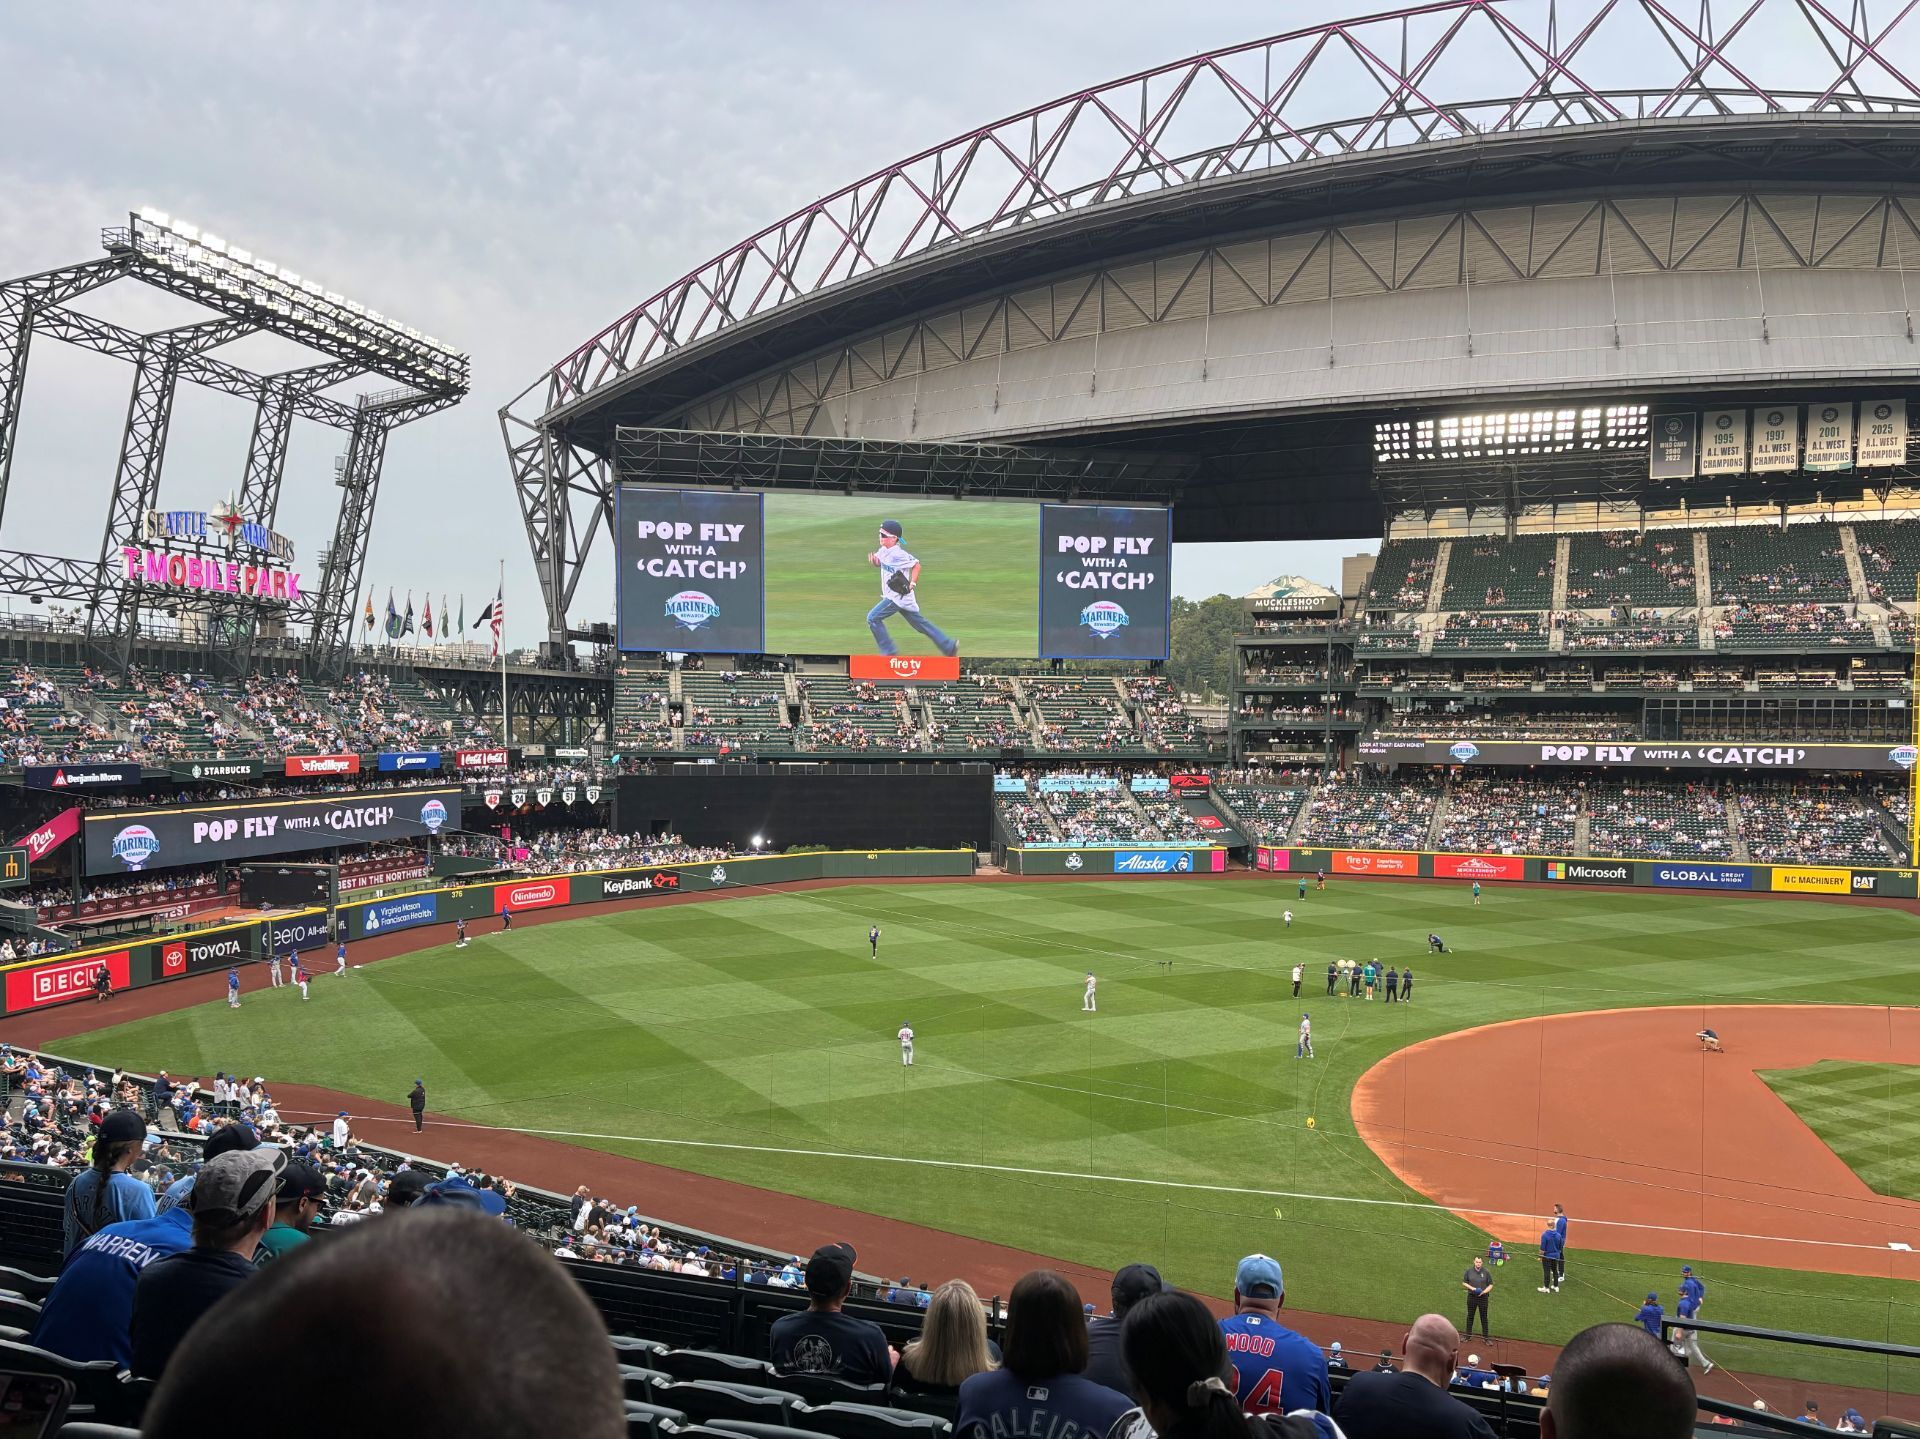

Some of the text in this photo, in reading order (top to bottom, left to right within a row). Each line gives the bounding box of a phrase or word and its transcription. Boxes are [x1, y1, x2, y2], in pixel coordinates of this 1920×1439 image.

[1819, 427, 1840, 438] 2001
[1872, 424, 1893, 434] 2025
[1714, 434, 1734, 444] 1995
[1765, 430, 1785, 441] 1997
[1758, 442, 1791, 453] A.L. WEST
[1812, 440, 1846, 450] A.L. WEST
[1866, 437, 1898, 447] A.L. WEST
[1707, 447, 1739, 457] A.L. WEST
[1808, 452, 1849, 463] CHAMPIONS
[1861, 449, 1902, 460] CHAMPIONS
[1703, 458, 1743, 469] CHAMPIONS
[1754, 455, 1795, 466] CHAMPIONS
[146, 510, 207, 538] SEATTLE
[638, 521, 745, 542] POP FLY
[241, 521, 294, 562] MARINERS
[1058, 535, 1154, 555] POP FLY
[665, 544, 716, 556] WITH A
[1081, 557, 1128, 568] WITH A
[122, 547, 300, 600] T-MOBILE PARK
[664, 600, 720, 617] MARINERS
[1255, 598, 1326, 607] MUCKLESHOOT
[1080, 611, 1129, 626] MARINERS
[890, 657, 921, 669] fire tv
[1541, 745, 1589, 761] POP
[1595, 746, 1636, 761] FLY
[1644, 750, 1678, 759] WITH
[1681, 750, 1692, 759] A
[204, 765, 251, 776] STARBUCKS
[67, 772, 123, 784] Benjamin Moore
[488, 796, 498, 805] 42
[515, 795, 524, 803] 24
[542, 794, 548, 803] 11
[566, 793, 574, 801] 51
[590, 792, 597, 800] 51
[193, 819, 238, 844] POP
[244, 816, 278, 839] FLY
[284, 817, 311, 830] WITH
[313, 816, 320, 827] A
[112, 836, 161, 857] MARINERS
[1068, 856, 1079, 864] 50
[1118, 854, 1168, 871] Alaska
[1346, 855, 1371, 864] fire tv
[359, 877, 368, 887] IN
[369, 874, 384, 885] THE
[386, 867, 431, 883] NORTHWES
[713, 869, 724, 877] 50
[1569, 866, 1627, 879] Microsoft
[1660, 870, 1718, 882] GLOBAL
[603, 878, 652, 894] KeyBank
[1798, 876, 1845, 886] MACHINERY
[1853, 876, 1877, 889] CAT
[451, 890, 463, 898] 376
[514, 889, 551, 902] Nintendo
[381, 902, 421, 917] Virginia Mason
[381, 910, 432, 926] Franciscan Health
[190, 940, 241, 962] TOYOTA
[82, 1233, 161, 1268] WARREN
[1225, 1332, 1276, 1358] WOOD
[1232, 1363, 1284, 1416] 4
[973, 1408, 1089, 1439] RALEIG
